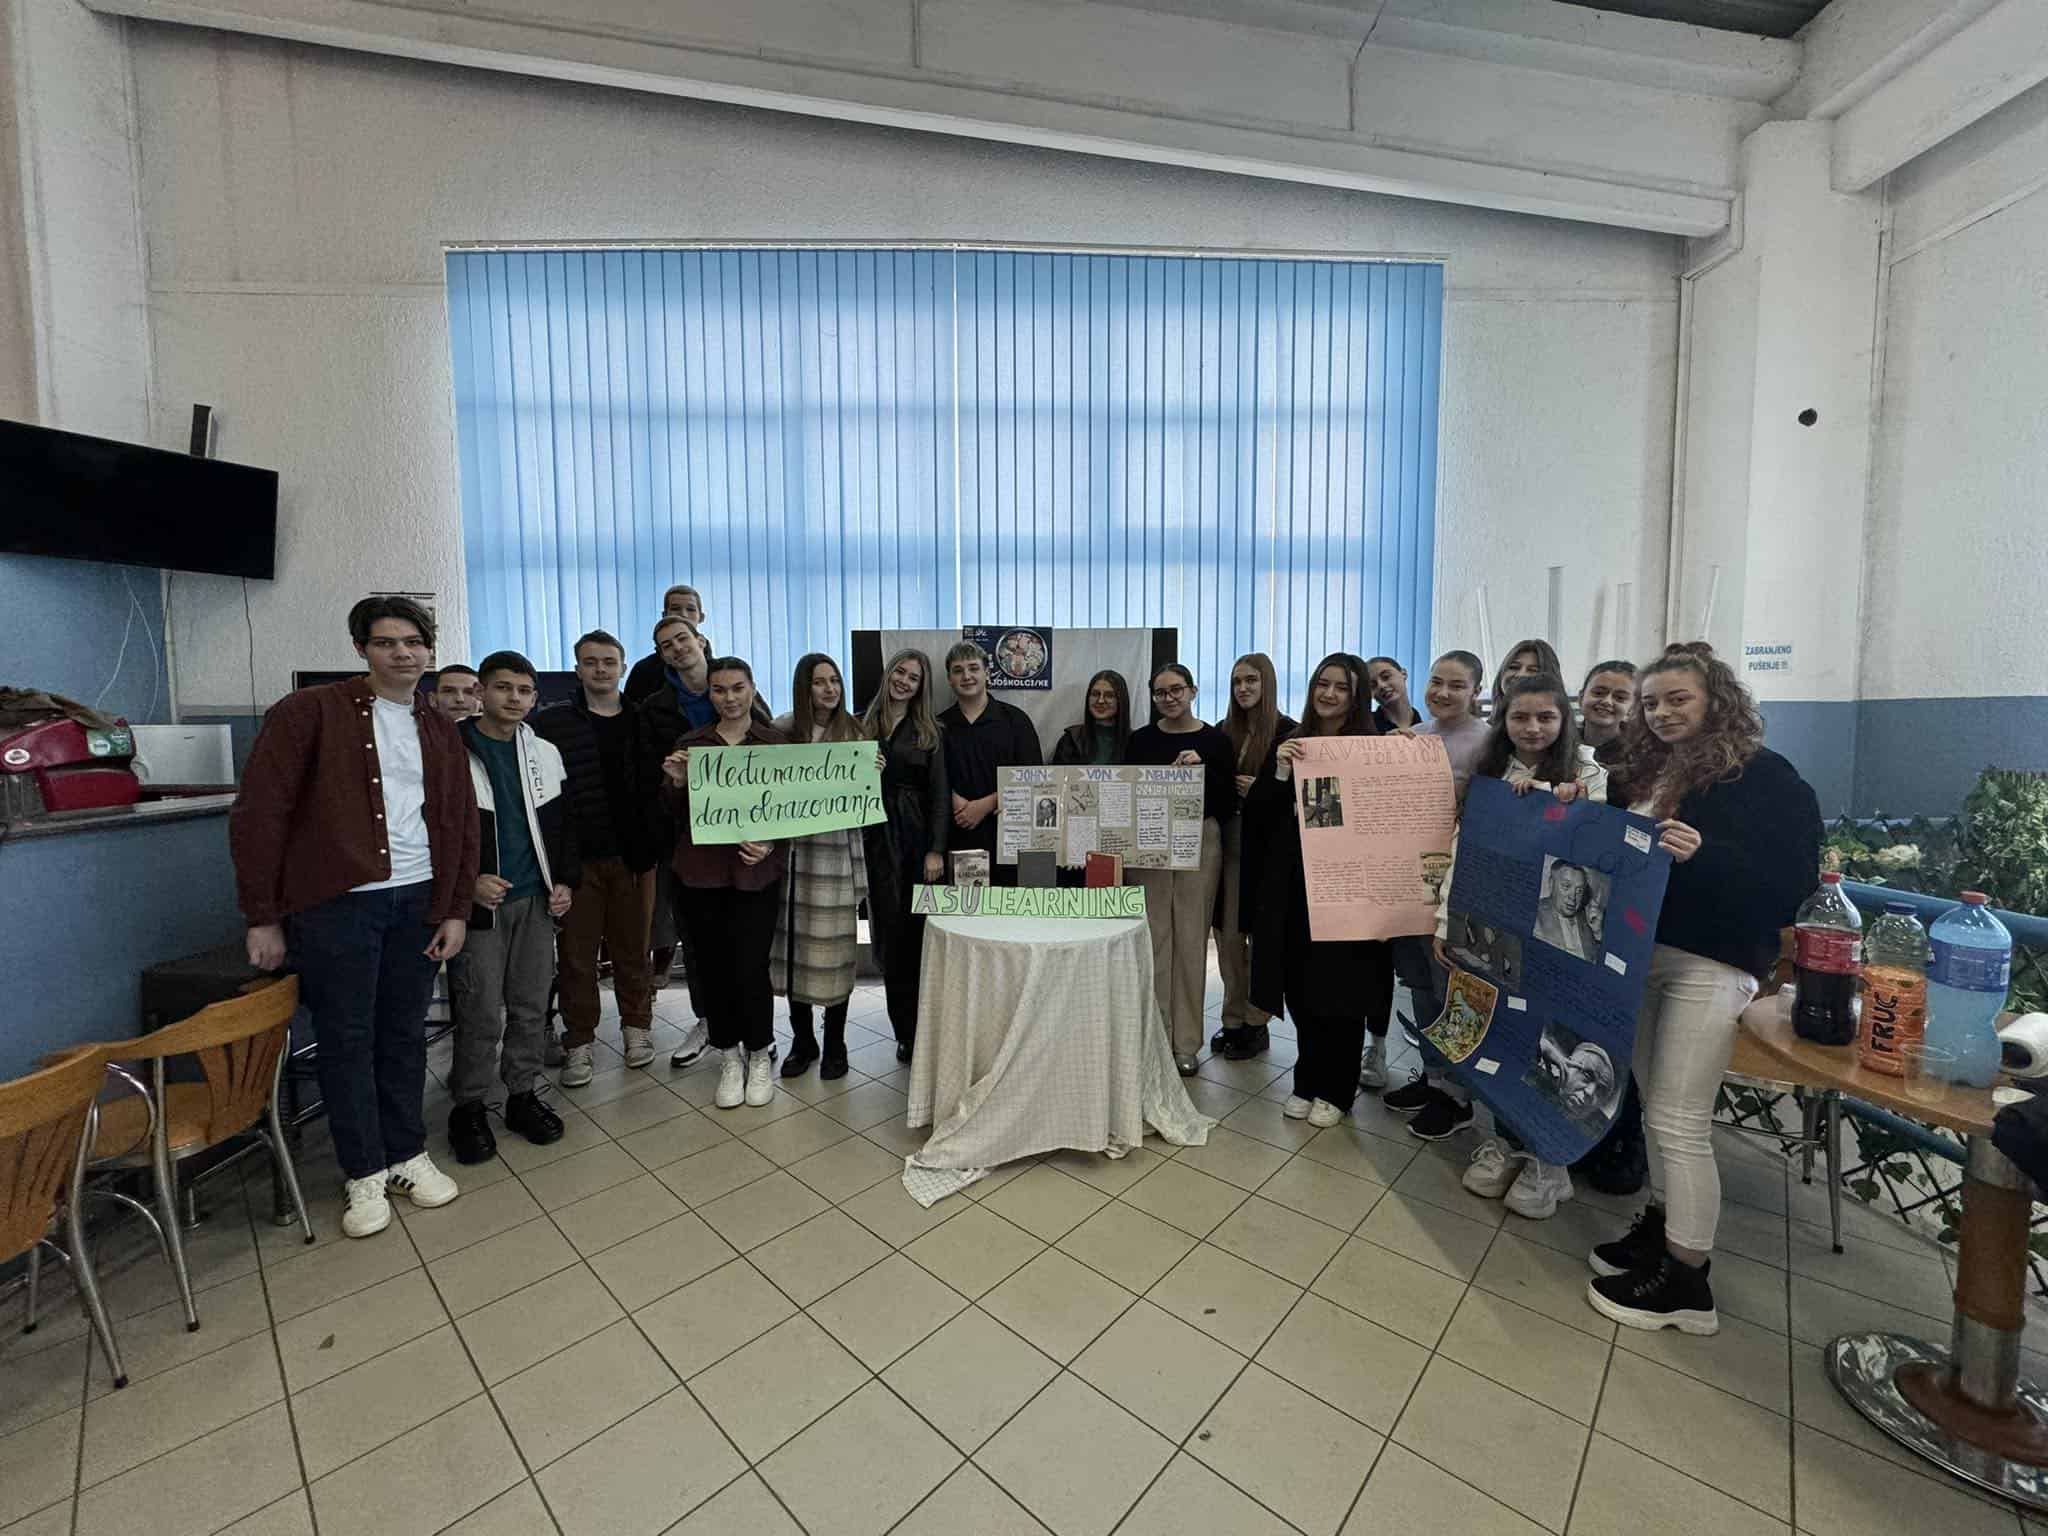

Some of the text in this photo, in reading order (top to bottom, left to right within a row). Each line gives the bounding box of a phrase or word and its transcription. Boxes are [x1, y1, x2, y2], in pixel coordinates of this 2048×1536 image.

[1745, 646, 1792, 655] ZABRANJENO
[1749, 660, 1779, 670] PUŠENJE
[1015, 768, 1193, 782] JOHN VON NEUMAN
[694, 784, 881, 829] dan obrazovanja
